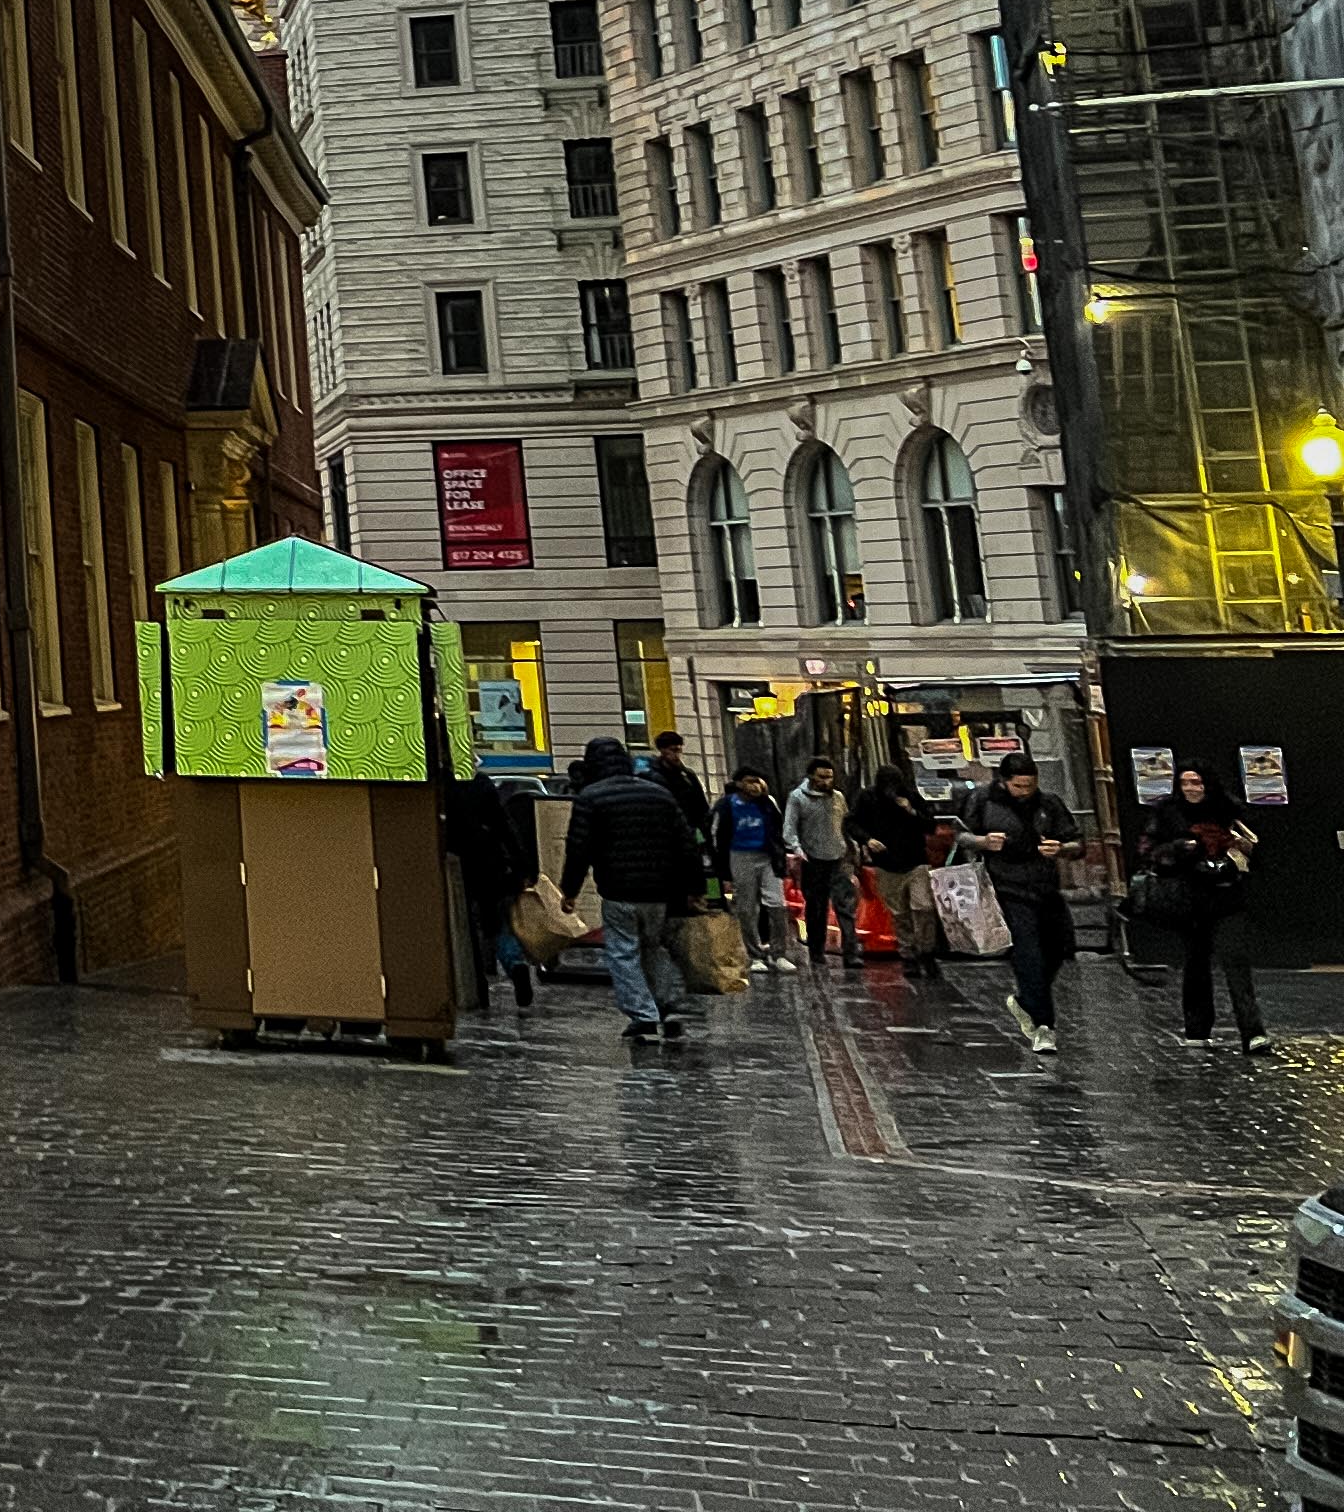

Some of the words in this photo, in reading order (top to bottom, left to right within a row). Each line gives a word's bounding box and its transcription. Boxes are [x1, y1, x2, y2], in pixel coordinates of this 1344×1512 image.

[443, 469, 487, 479] OFFICE
[443, 479, 482, 489] SPACE
[445, 490, 470, 500] FOR
[445, 500, 485, 510] LEASE
